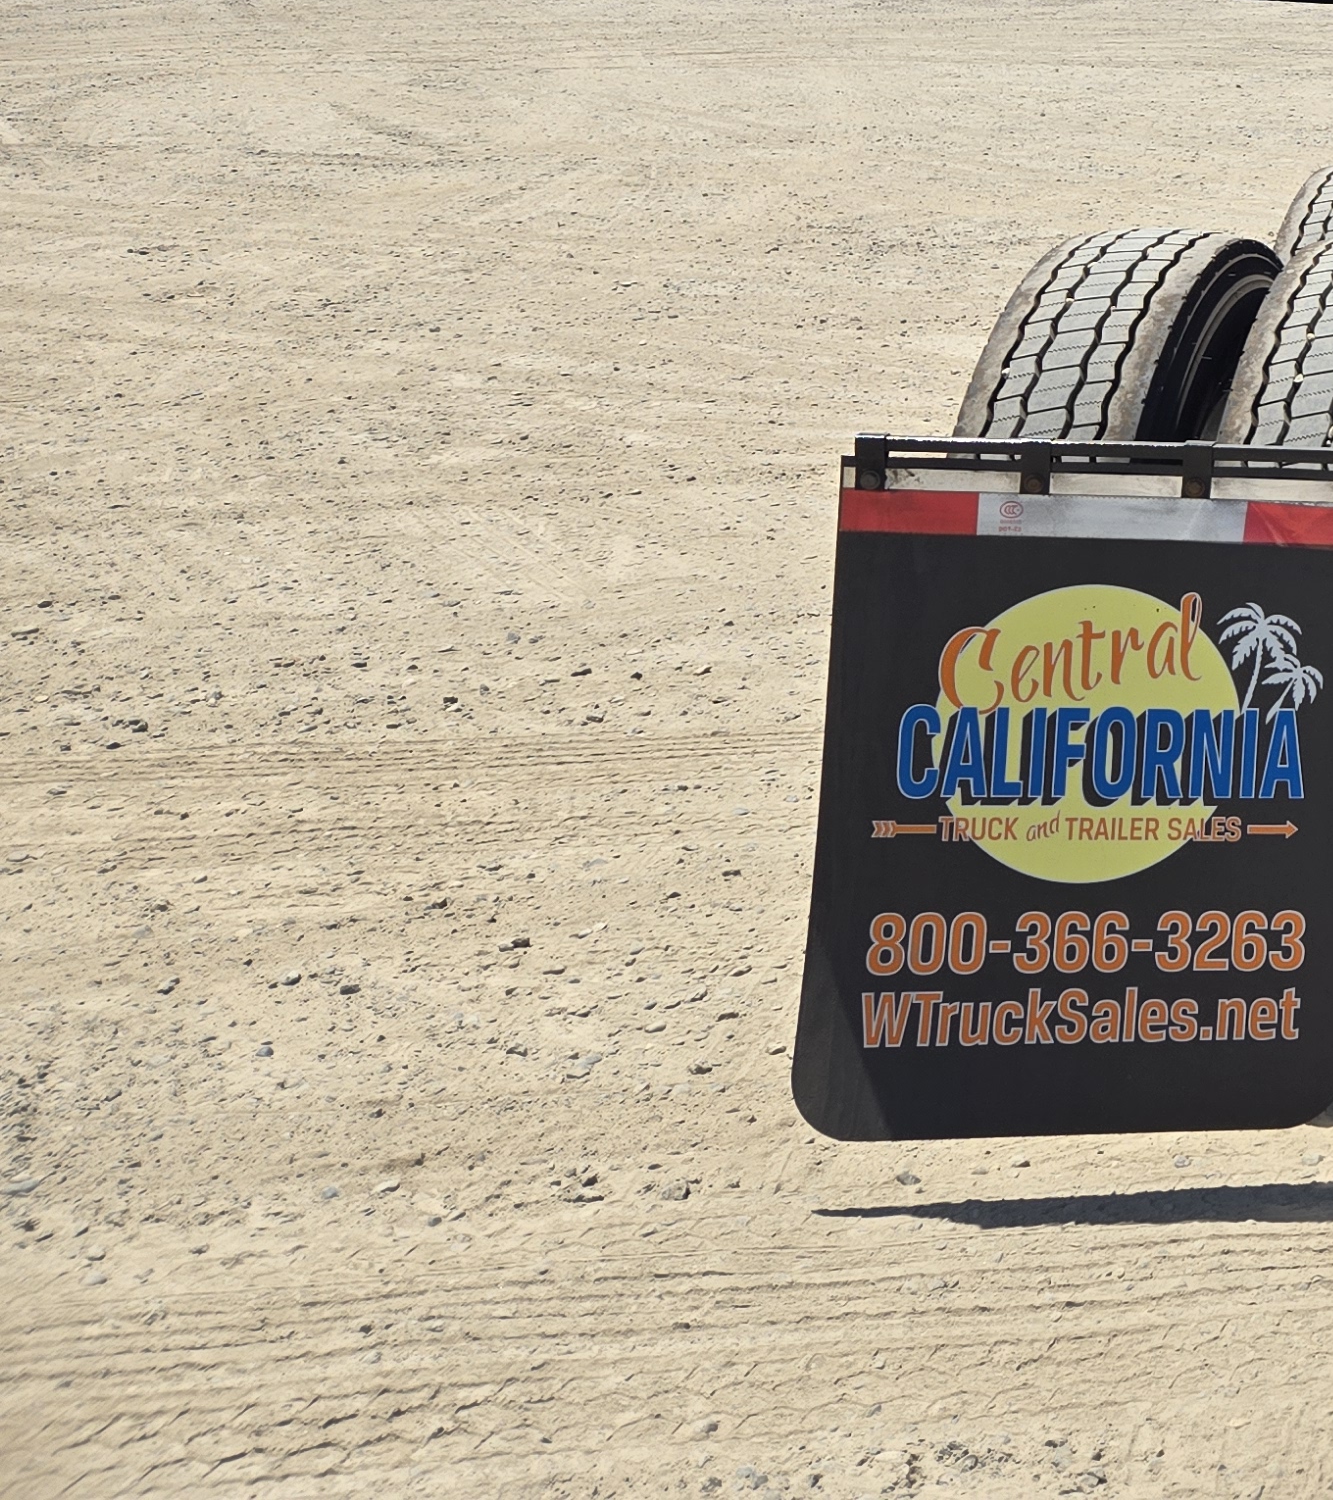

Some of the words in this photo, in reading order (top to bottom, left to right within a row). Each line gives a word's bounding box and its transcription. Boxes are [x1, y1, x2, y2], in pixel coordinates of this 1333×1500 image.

[938, 592, 1202, 715] Central
[896, 703, 1305, 804] CALIFORNIA
[939, 816, 1019, 841] TRUCK
[1026, 811, 1060, 842] and
[1066, 816, 1160, 841] TRAILER
[1167, 816, 1242, 841] SALES
[865, 910, 1306, 976] 800-366-3263
[861, 987, 1300, 1047] WTruckSales.net
